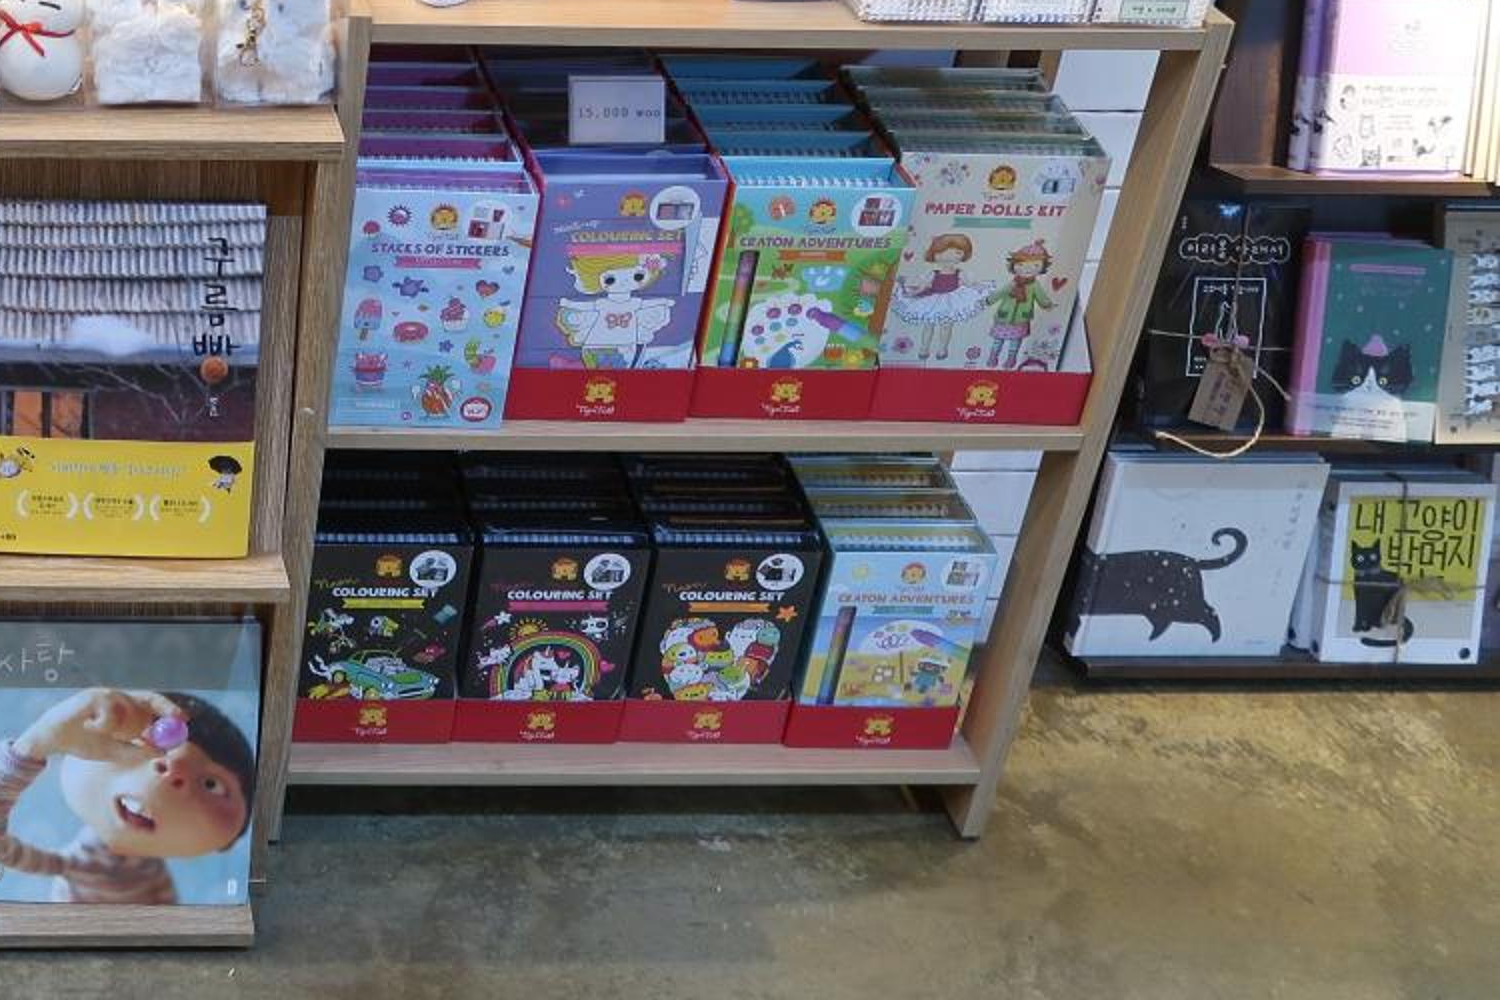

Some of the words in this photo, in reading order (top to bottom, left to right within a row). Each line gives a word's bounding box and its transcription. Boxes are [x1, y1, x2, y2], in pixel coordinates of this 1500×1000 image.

[579, 107, 629, 119] 15,000
[924, 203, 976, 216] PAPER
[981, 204, 1034, 217] DOLLS
[1036, 204, 1068, 218] KIT
[371, 243, 424, 255] STACKS
[424, 243, 446, 256] OF
[446, 244, 510, 257] STICKERS
[797, 236, 893, 250] ADVENTURES
[192, 236, 242, 384] 구름빵
[1355, 499, 1387, 535] 내
[1393, 498, 1480, 541] 고양이
[331, 586, 411, 599] COLOURING
[412, 586, 439, 599] SET
[507, 589, 586, 601] COLOURING
[586, 590, 613, 601] SET
[678, 590, 758, 602] COLOURING
[759, 590, 785, 602] SET
